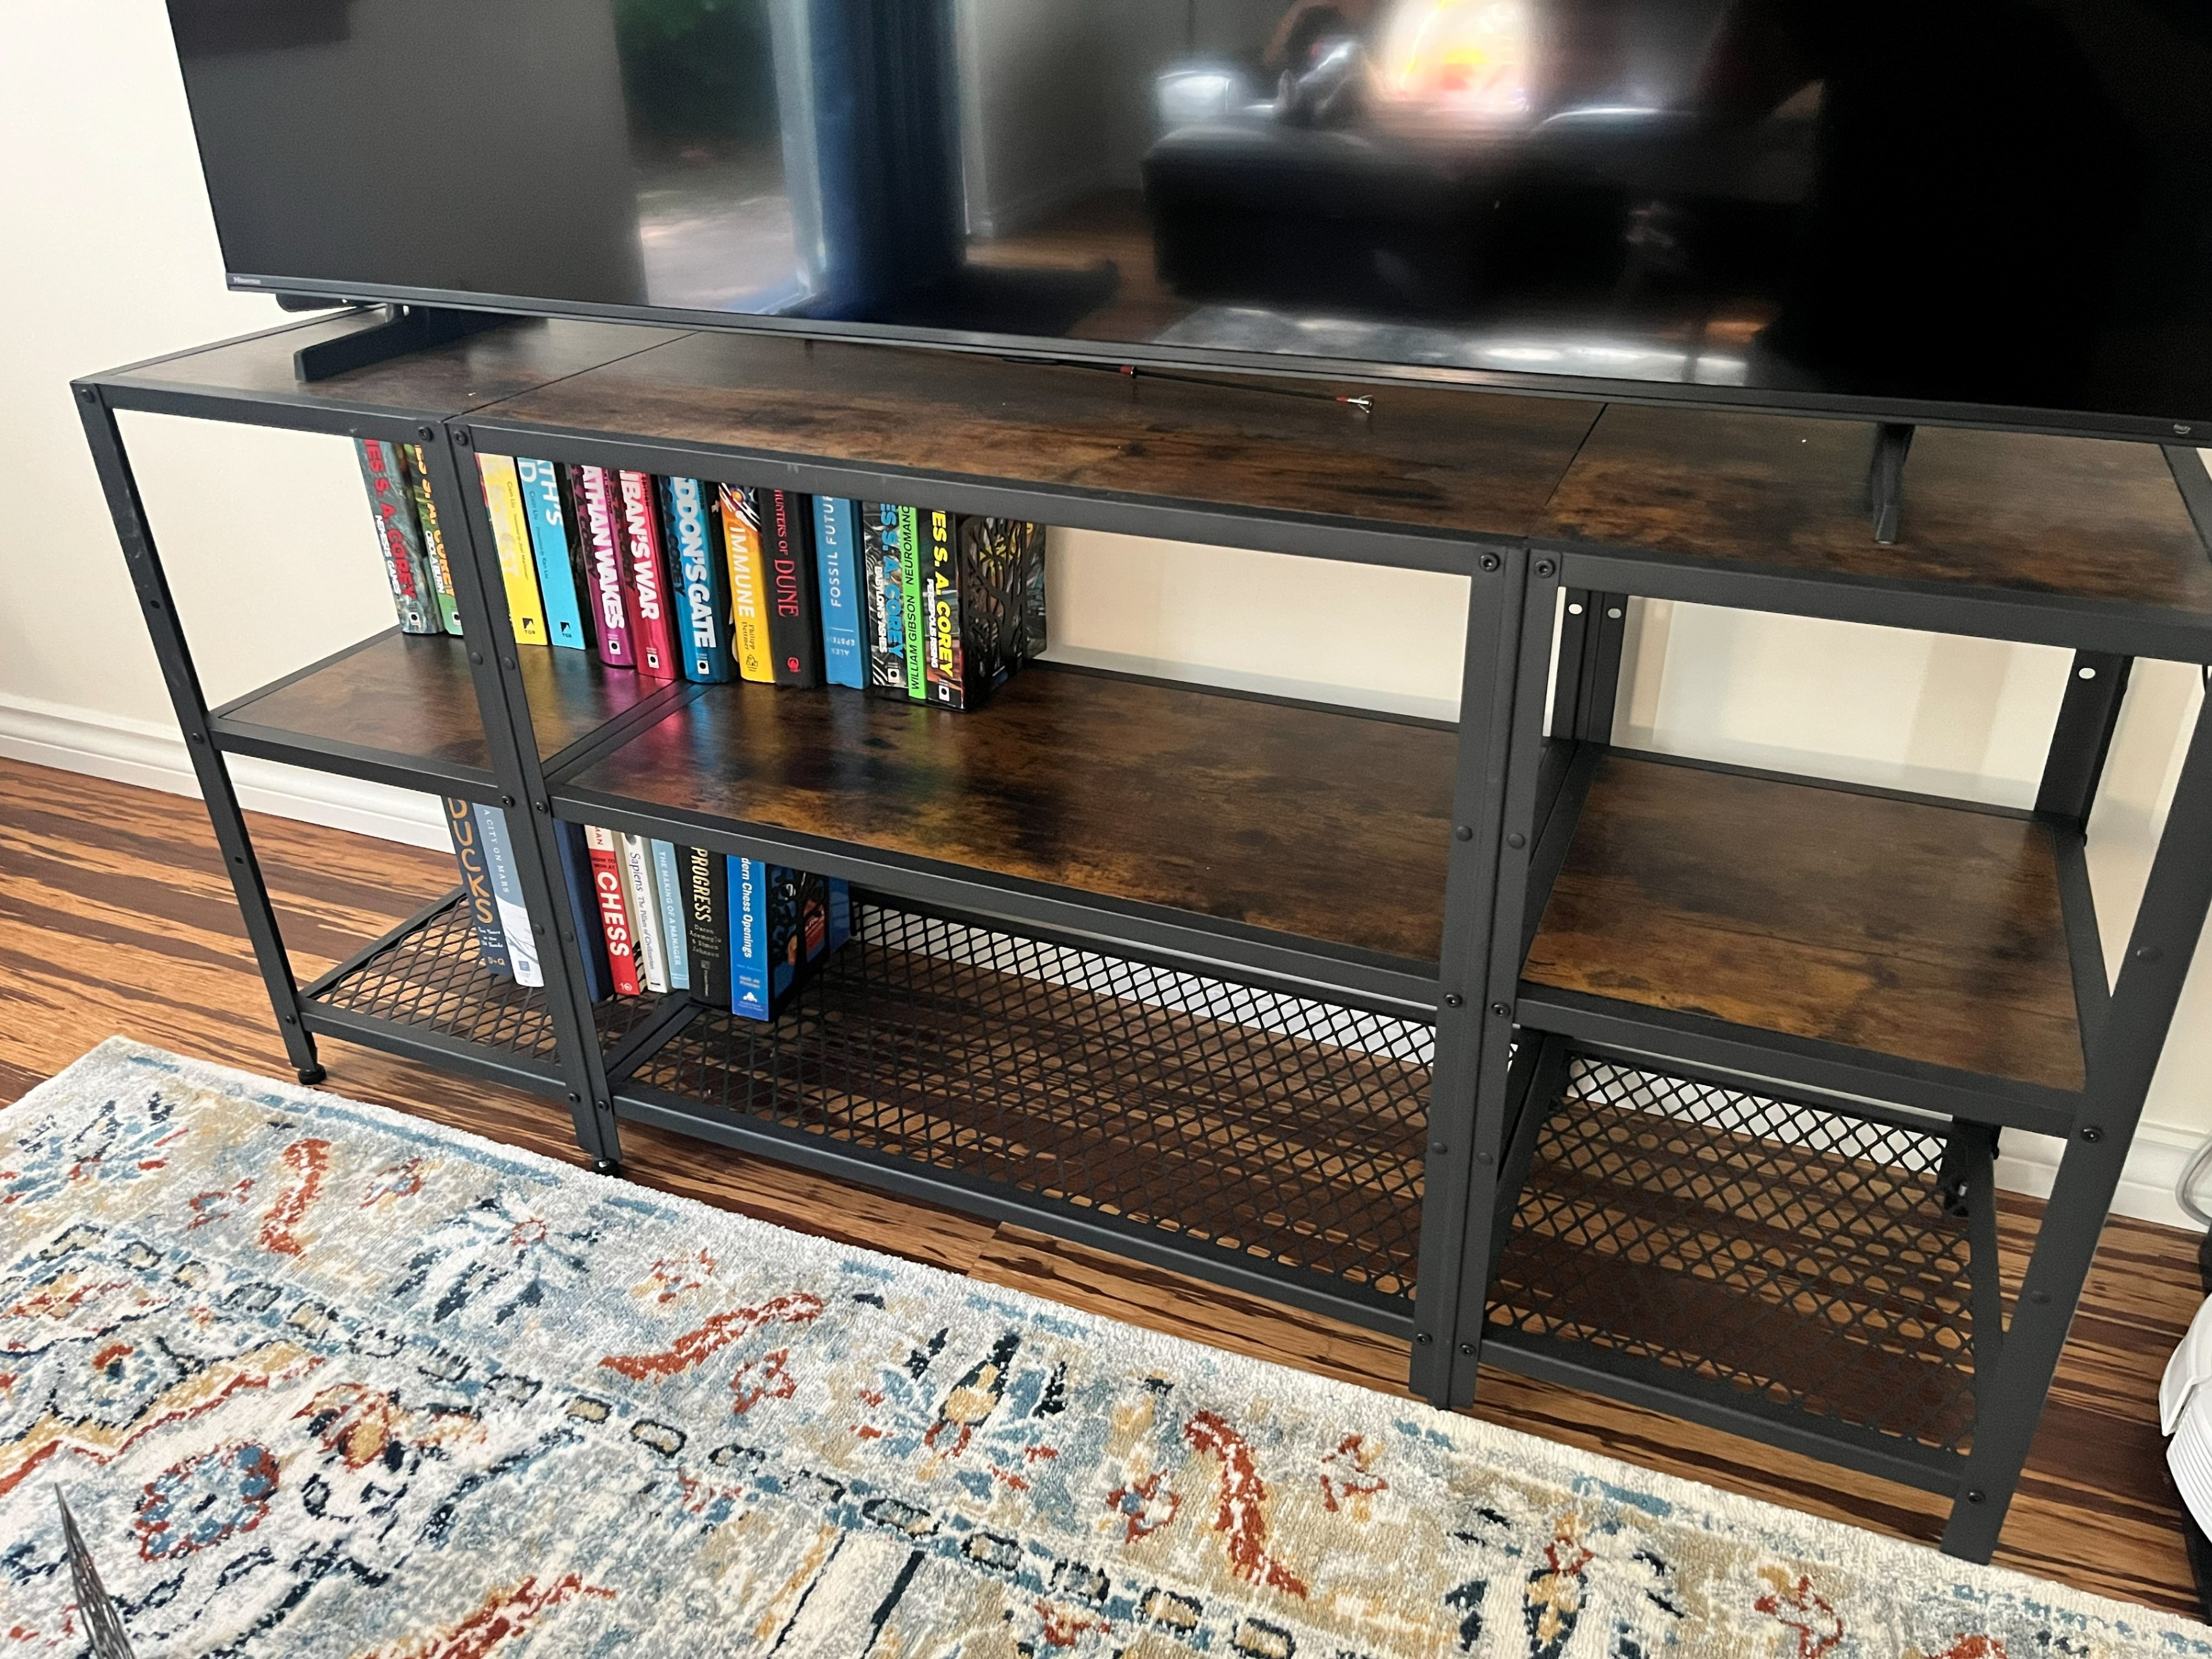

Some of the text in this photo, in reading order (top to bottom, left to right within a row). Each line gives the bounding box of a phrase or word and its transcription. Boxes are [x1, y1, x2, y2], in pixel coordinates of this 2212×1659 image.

[375, 515, 401, 595] NEMESIS GAMES
[619, 469, 660, 621] IBAN'S WAR
[778, 540, 789, 556] OF
[882, 530, 898, 551] S.
[933, 545, 949, 567] S.
[387, 528, 418, 599] COREY
[673, 477, 716, 648] DDON'S GATE
[730, 526, 755, 618] IMMUNE
[828, 552, 842, 608] FOSSIL
[883, 556, 899, 580] A.
[935, 570, 949, 595] A.
[595, 547, 625, 629] WAKES
[774, 559, 800, 618] DUNE
[878, 620, 888, 654] ASHES
[885, 584, 904, 659] COREY
[907, 595, 917, 642] GIBSON
[936, 601, 953, 678] COREY
[911, 644, 920, 690] WILLIAM
[486, 819, 499, 843] CITY
[493, 847, 503, 861] ON
[629, 852, 643, 892] Sapiens
[658, 851, 668, 869] THE
[497, 865, 510, 893] MARS
[662, 870, 673, 904] MAKING
[691, 847, 712, 923] PROGRESS
[742, 882, 753, 912] Chess
[597, 871, 630, 957] CHESS
[668, 906, 675, 920] OF
[670, 924, 681, 966] MANAGER
[742, 914, 753, 958] Openings
